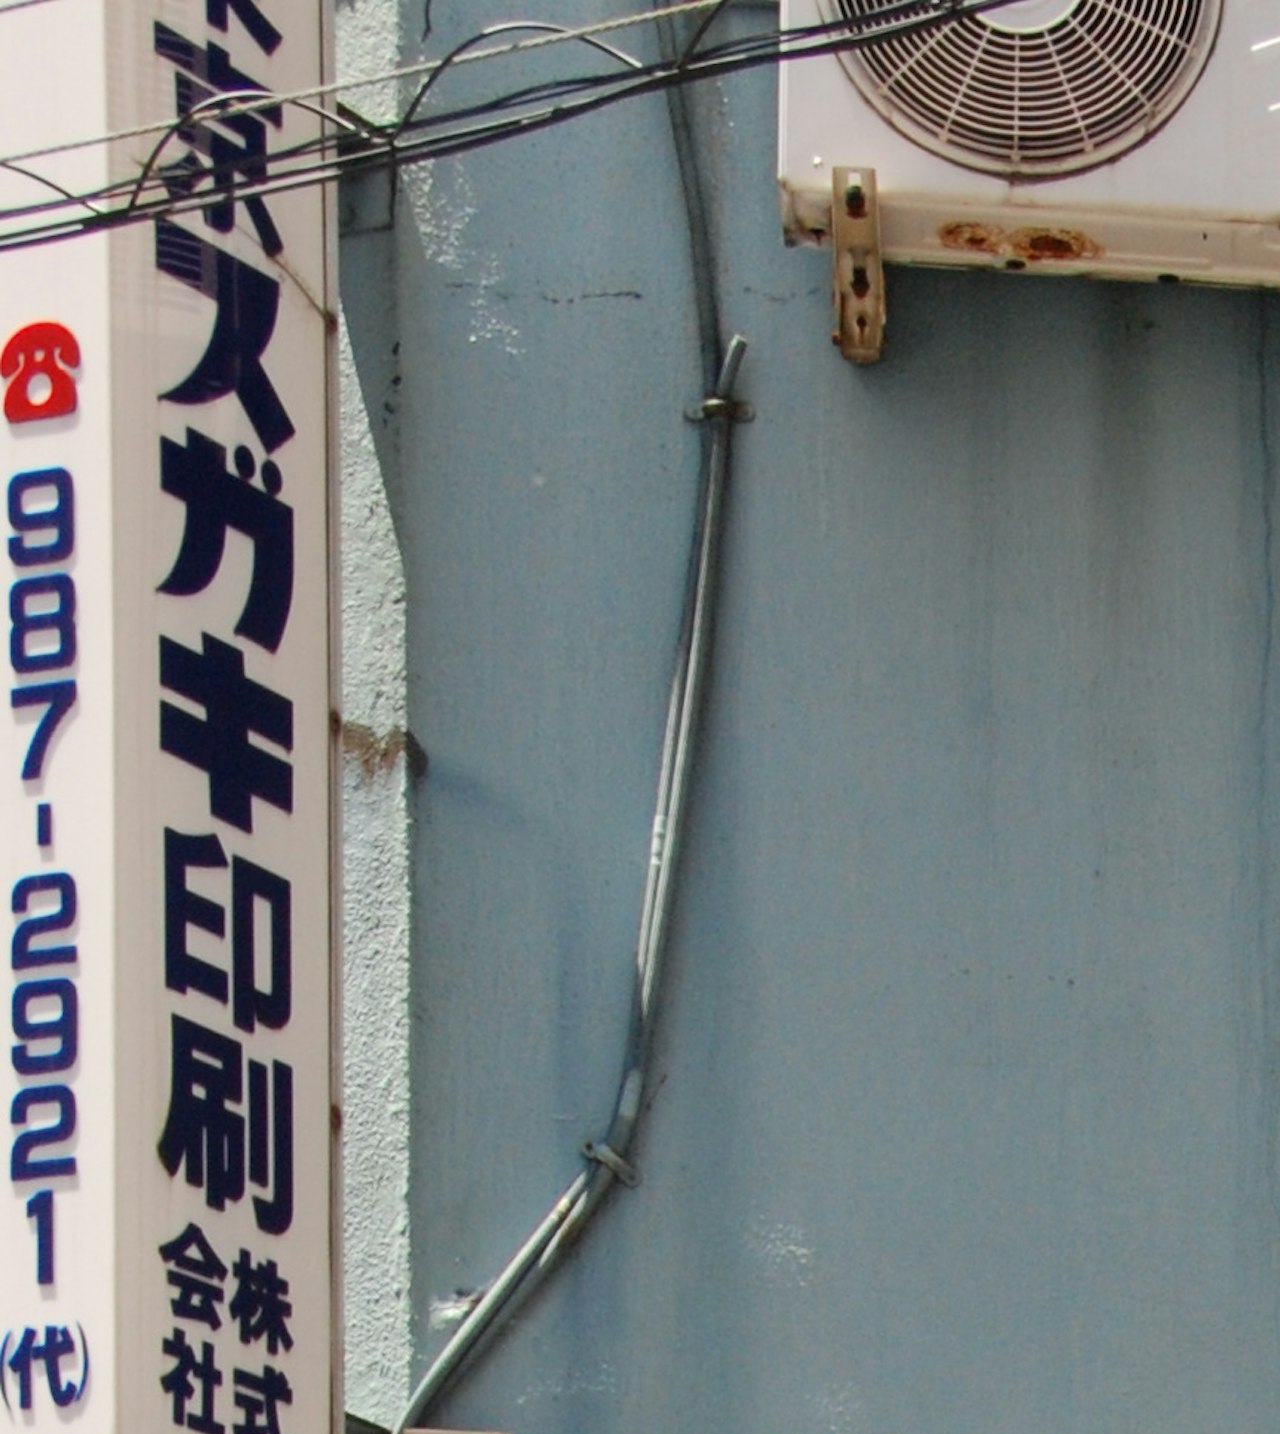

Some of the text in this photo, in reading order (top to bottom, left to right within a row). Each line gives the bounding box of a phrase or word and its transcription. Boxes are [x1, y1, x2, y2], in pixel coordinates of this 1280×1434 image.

[153, 0, 296, 1236] 京スガキ印刷
